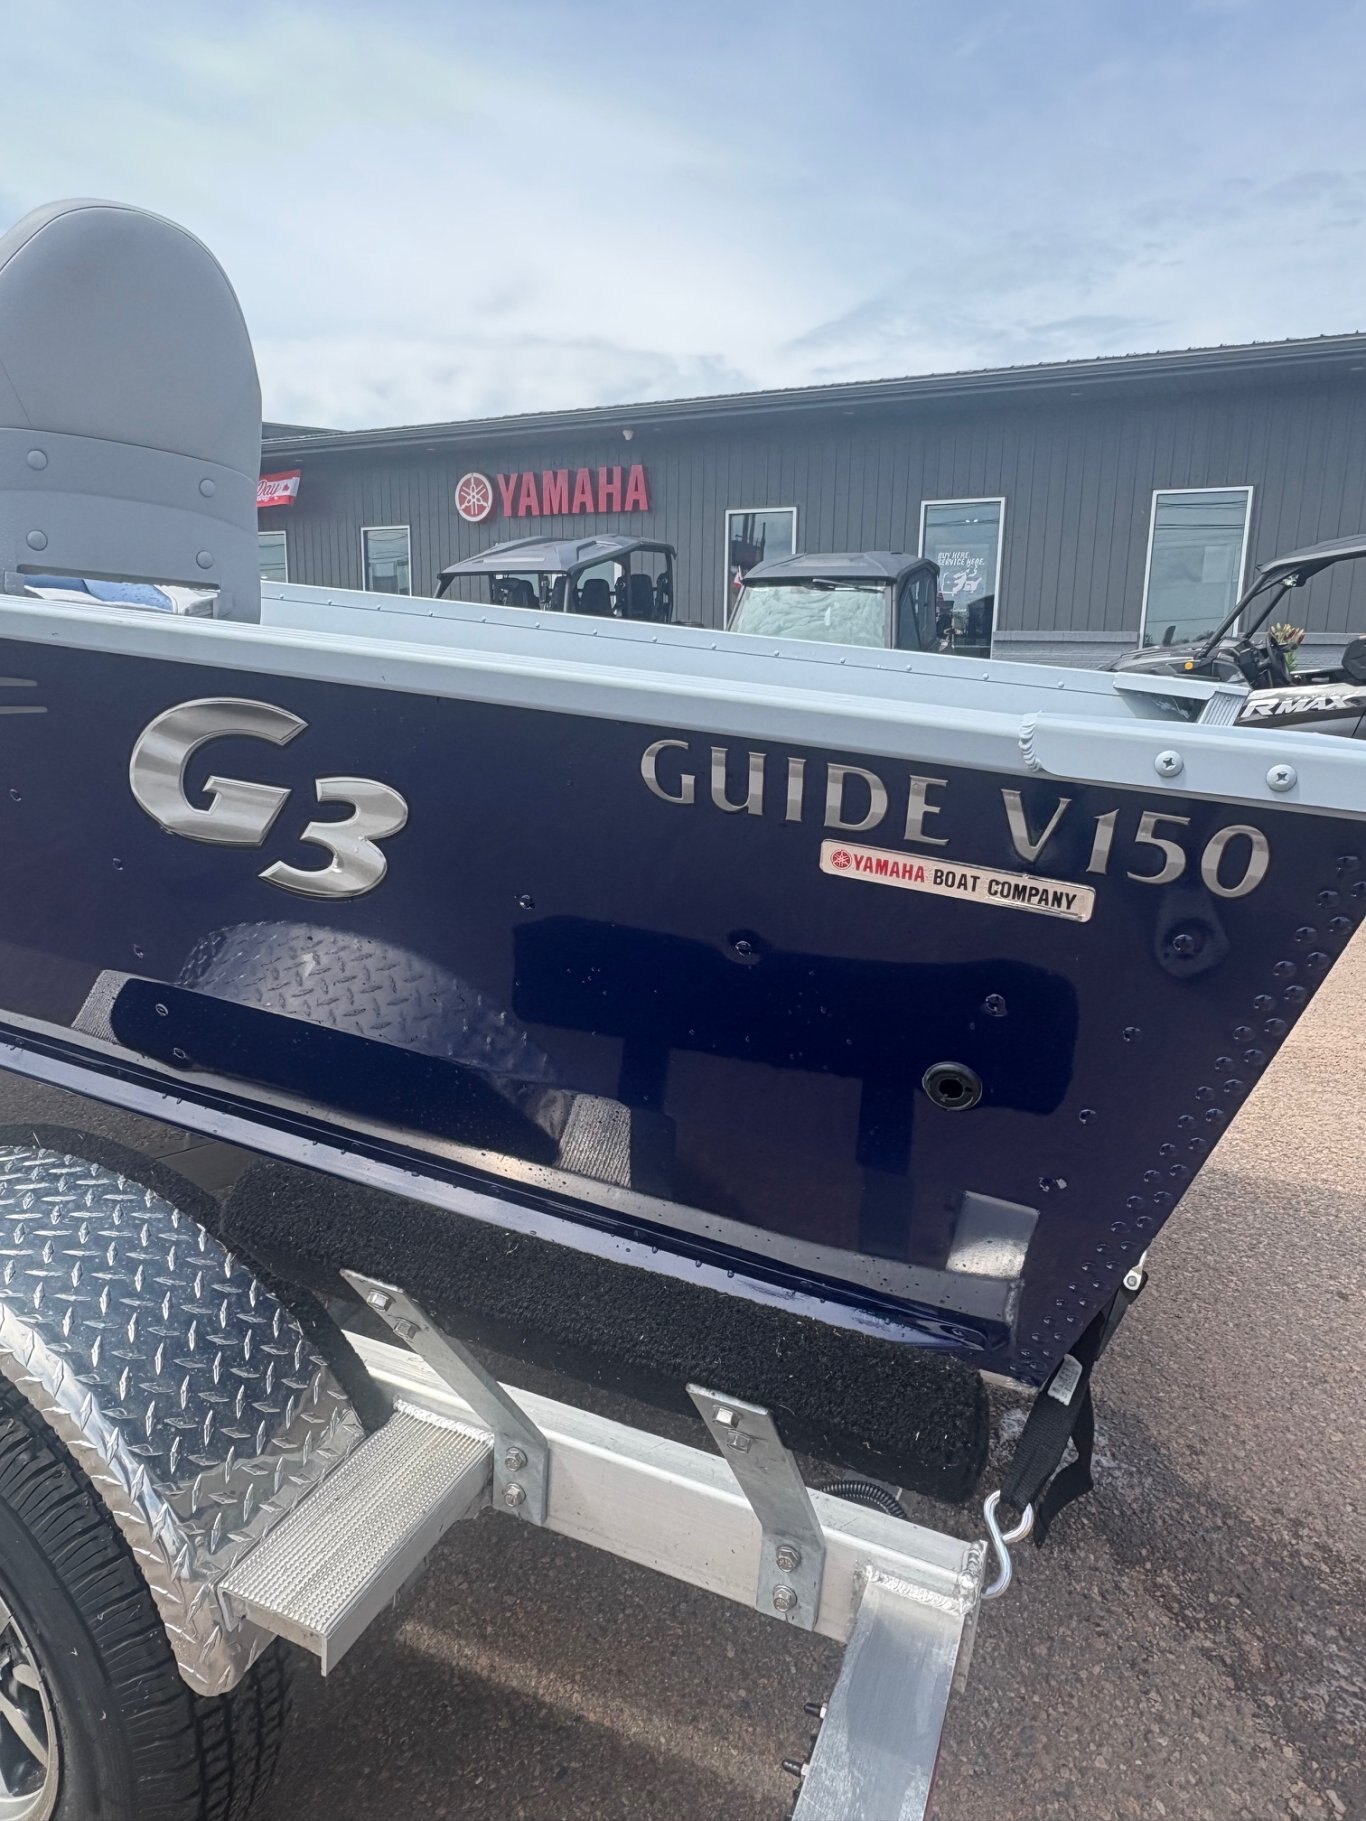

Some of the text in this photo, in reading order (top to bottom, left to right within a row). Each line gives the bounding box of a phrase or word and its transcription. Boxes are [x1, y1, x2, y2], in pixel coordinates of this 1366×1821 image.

[497, 464, 649, 517] YAMAHA
[938, 558, 965, 566] SERVICE
[1240, 695, 1347, 718] RMAX
[129, 696, 408, 898] G3
[640, 739, 949, 846] GUIDE
[853, 853, 1078, 911] YAMAHA BOAT COMPANY
